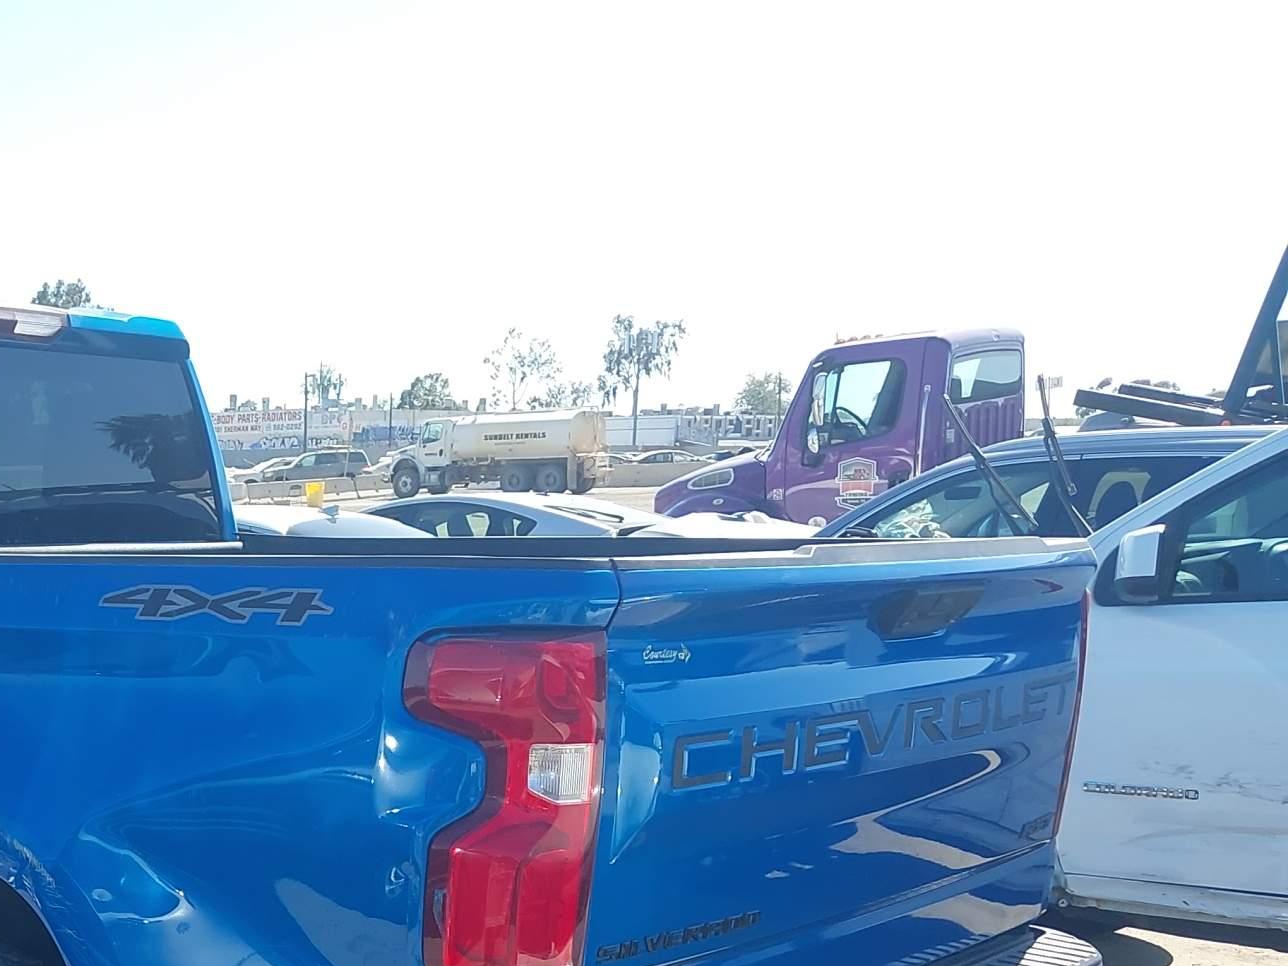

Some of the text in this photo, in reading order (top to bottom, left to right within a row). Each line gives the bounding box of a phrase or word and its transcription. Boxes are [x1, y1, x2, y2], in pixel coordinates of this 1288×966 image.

[483, 431, 546, 441] SUNBELT RENTALS
[671, 670, 1074, 792] CHEVROLET
[1082, 781, 1200, 801] COLORADO
[595, 909, 761, 964] SILVERADO
